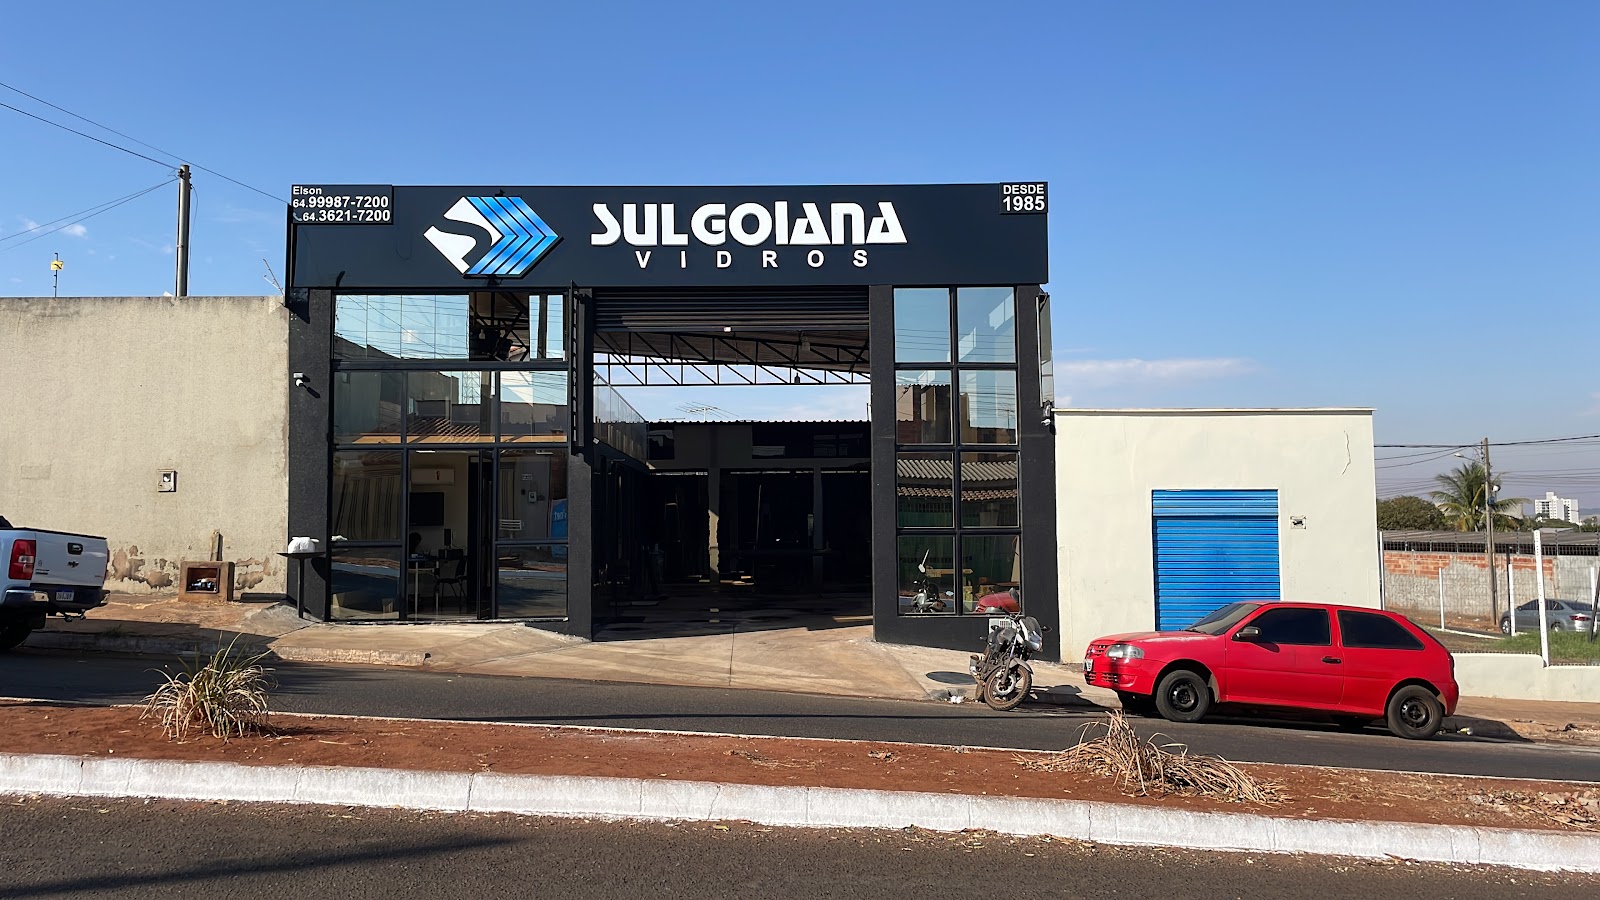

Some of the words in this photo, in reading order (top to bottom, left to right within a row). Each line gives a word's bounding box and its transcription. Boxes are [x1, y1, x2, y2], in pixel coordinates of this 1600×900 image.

[292, 186, 322, 195] Elson
[1003, 184, 1045, 195] DESDE
[292, 196, 389, 208] 64.99987-7200
[1003, 195, 1045, 212] 1985
[302, 209, 391, 222] 64.3621-7200
[635, 249, 868, 269] VIDROS
